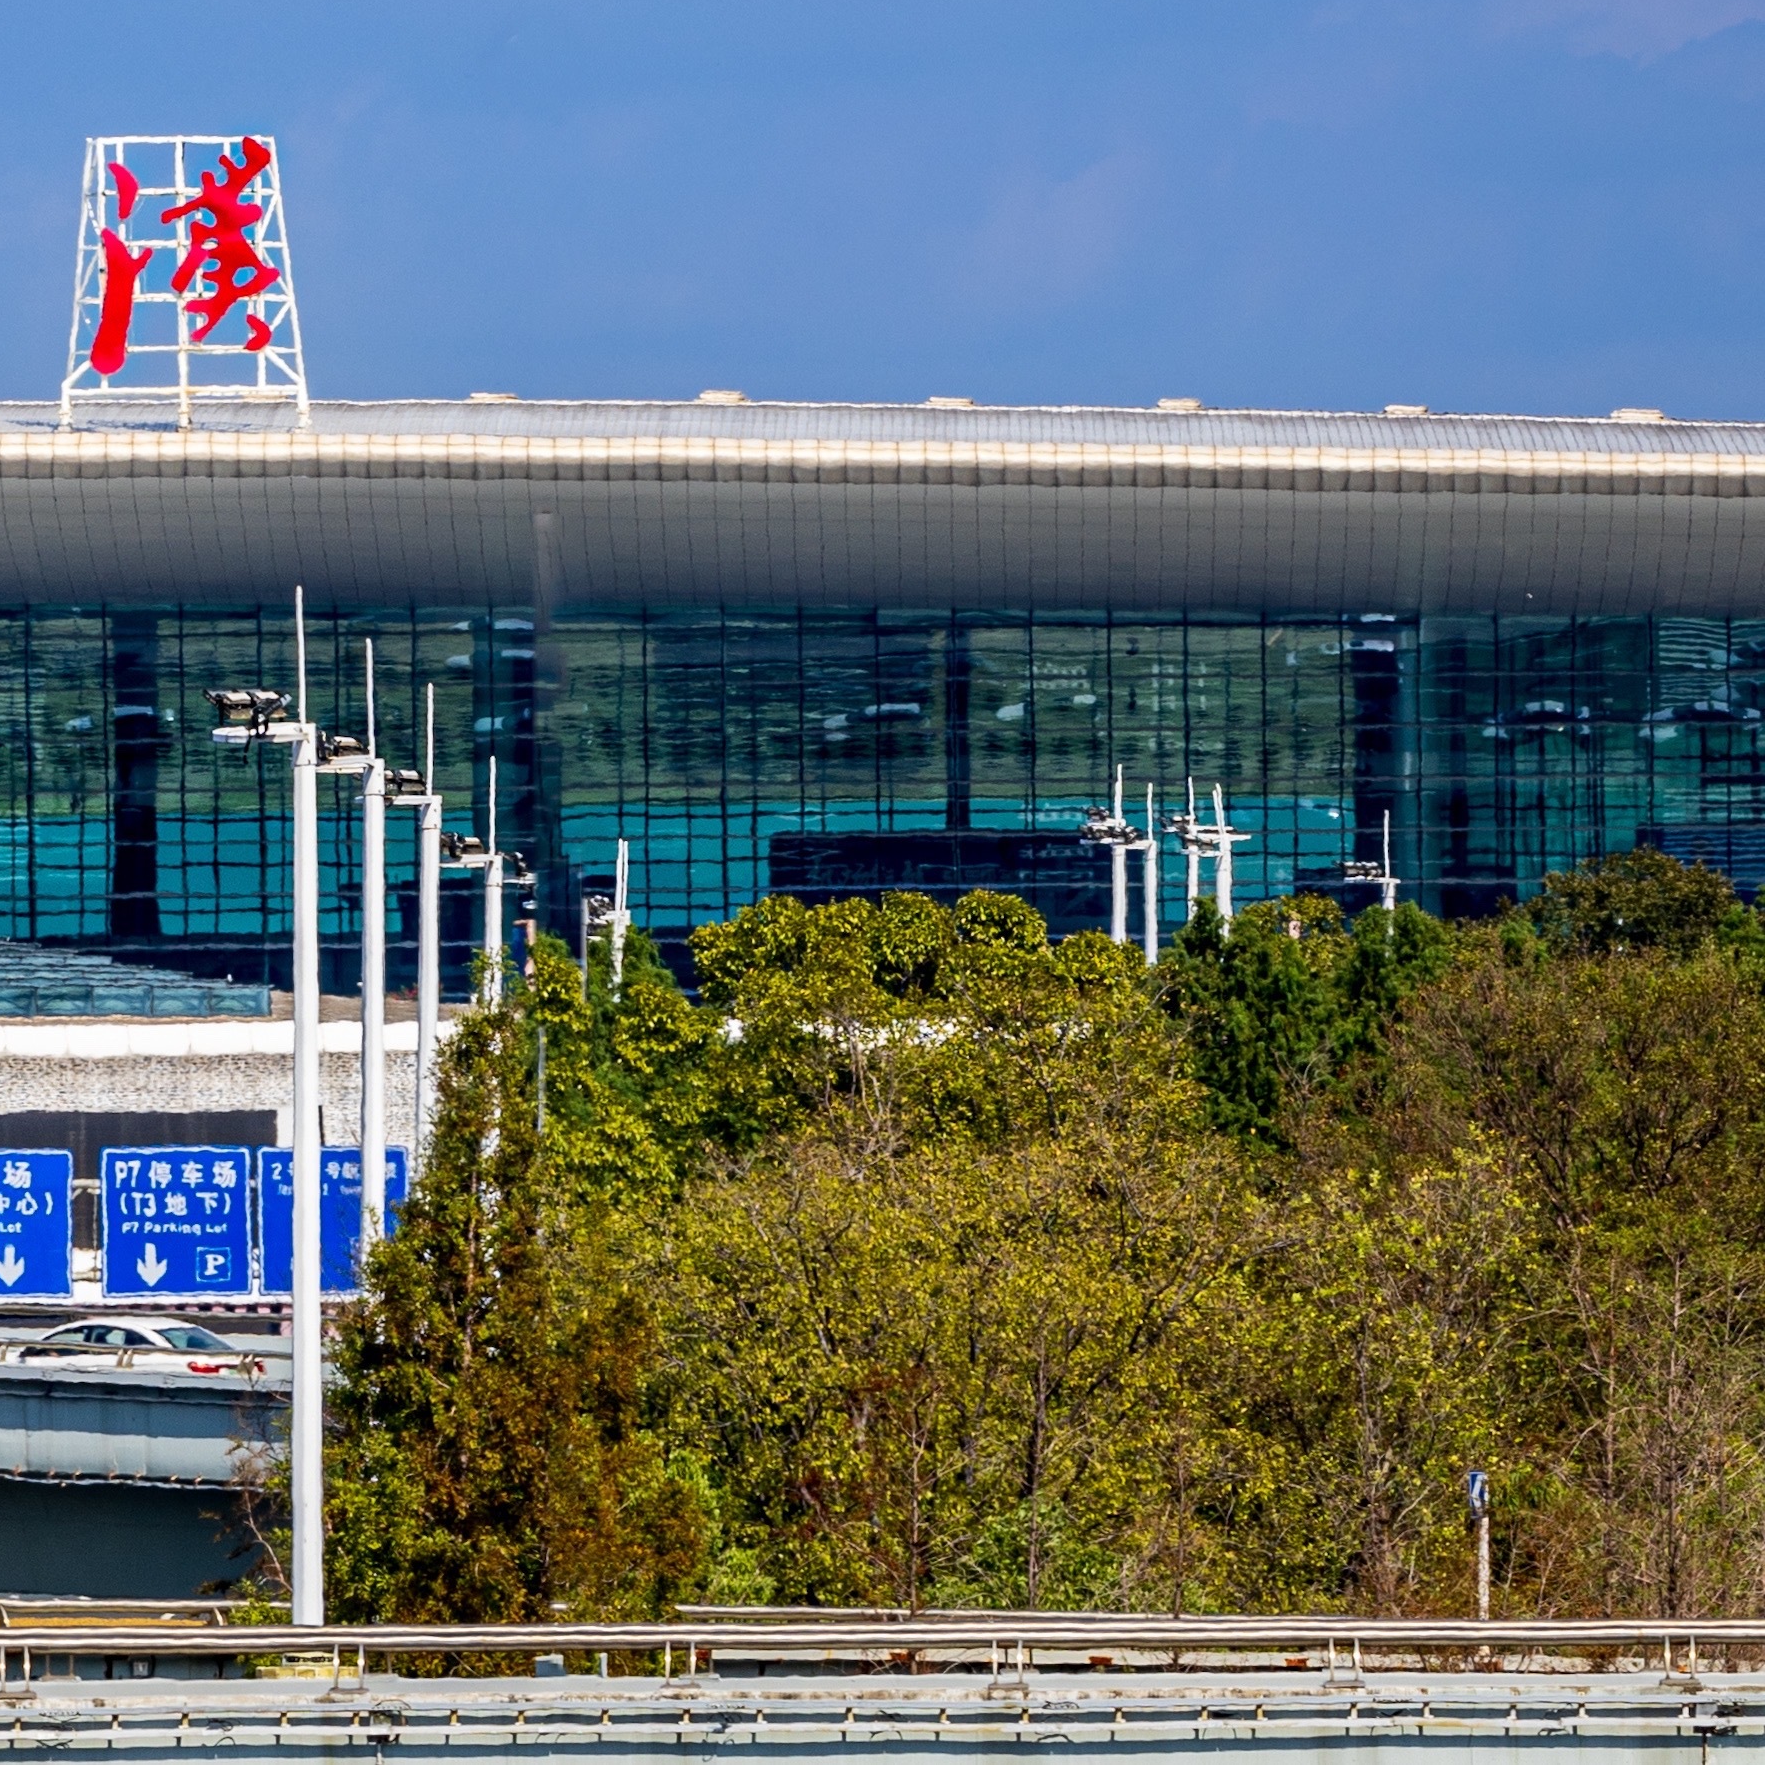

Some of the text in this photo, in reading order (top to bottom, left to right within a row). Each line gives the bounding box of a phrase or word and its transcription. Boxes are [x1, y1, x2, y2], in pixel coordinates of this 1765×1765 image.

[144, 1221, 201, 1235] Parking
[205, 1222, 228, 1233] Lot
[204, 1253, 226, 1276] P
